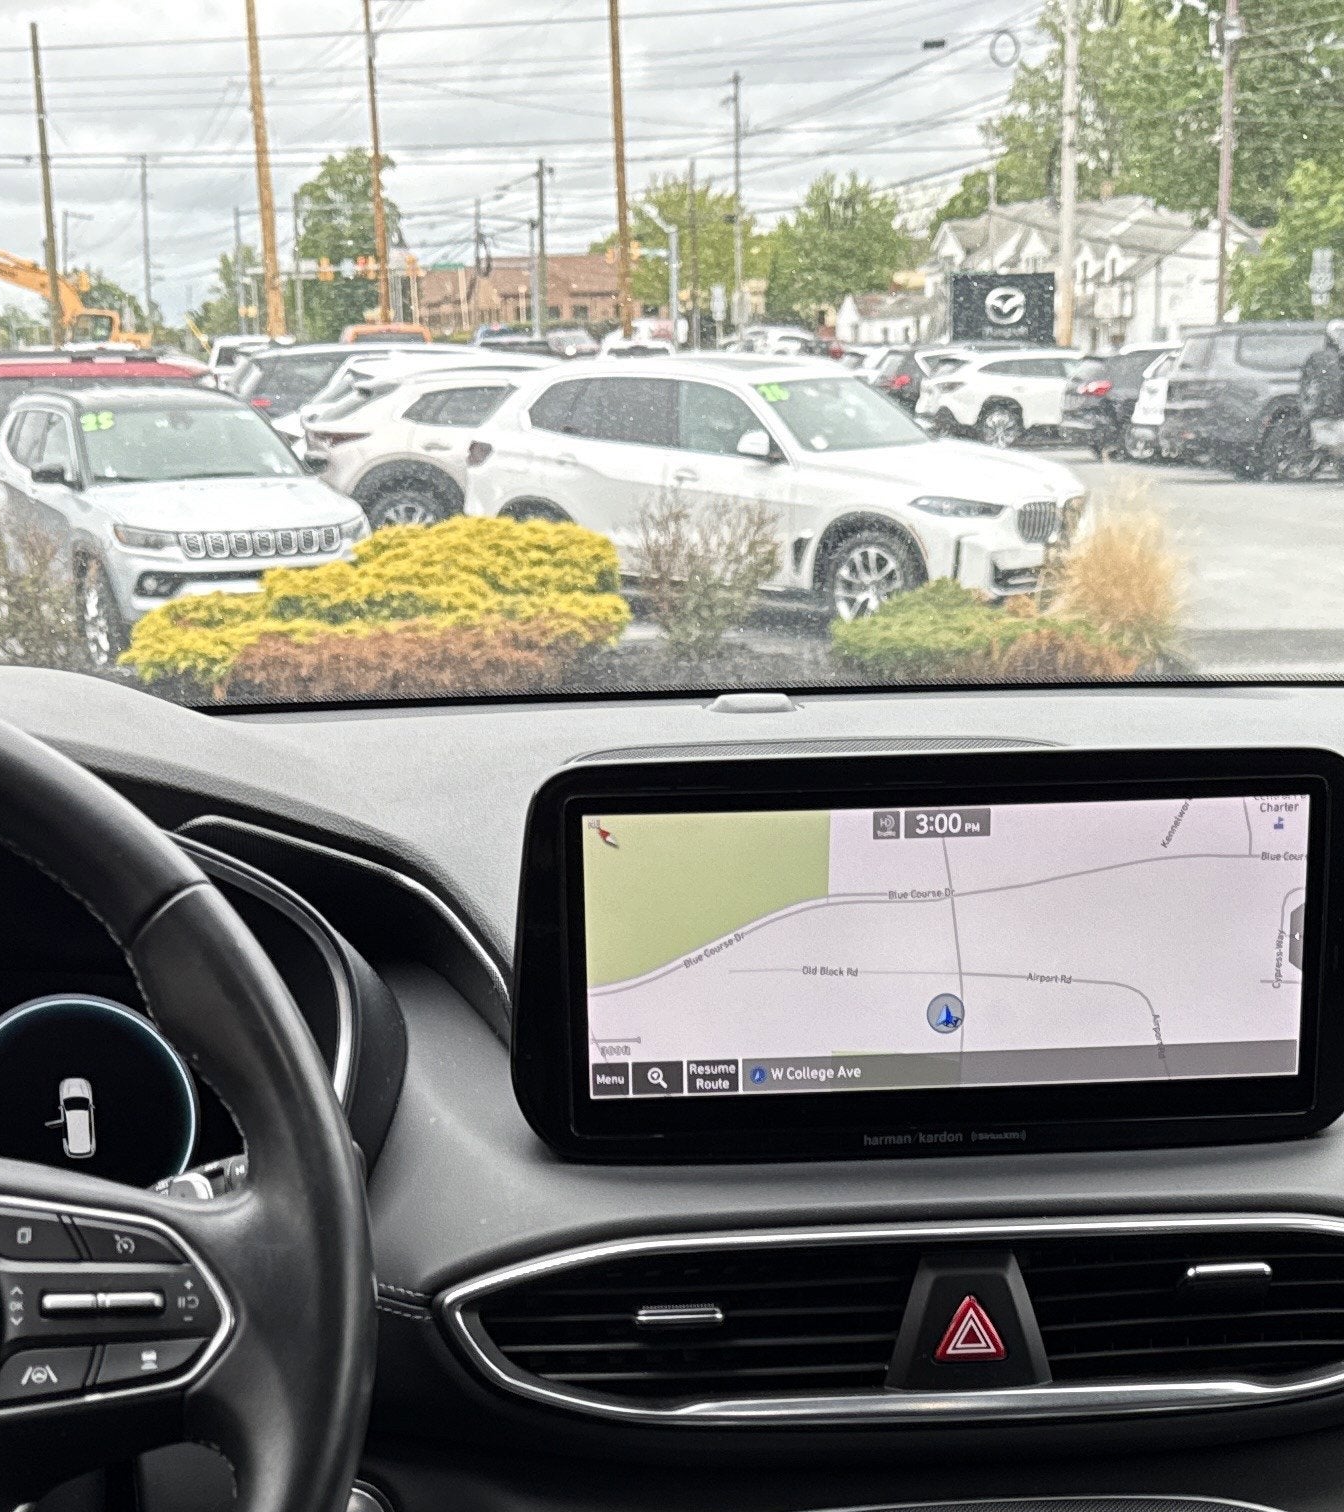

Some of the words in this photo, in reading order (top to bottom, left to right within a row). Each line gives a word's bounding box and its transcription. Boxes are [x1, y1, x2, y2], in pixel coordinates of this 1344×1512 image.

[1259, 802, 1299, 813] Charter
[915, 812, 962, 835] 3:00
[964, 822, 981, 833] PM
[1261, 852, 1281, 861] Blue
[888, 890, 909, 900] Blue
[910, 888, 944, 899] Course
[944, 888, 956, 898] Dr
[683, 953, 706, 969] Blue
[704, 936, 736, 957] Course
[734, 931, 746, 942] Dr
[801, 965, 818, 975] Old
[846, 967, 859, 977] Rd
[1271, 952, 1283, 989] Cypress
[1026, 972, 1058, 983] Airport
[1060, 974, 1073, 984] Rd
[689, 1062, 736, 1076] Resume
[770, 1067, 784, 1080] W
[786, 1066, 835, 1082] College
[837, 1065, 862, 1079] Ave
[596, 1073, 625, 1086] Menu
[696, 1077, 731, 1092] Route
